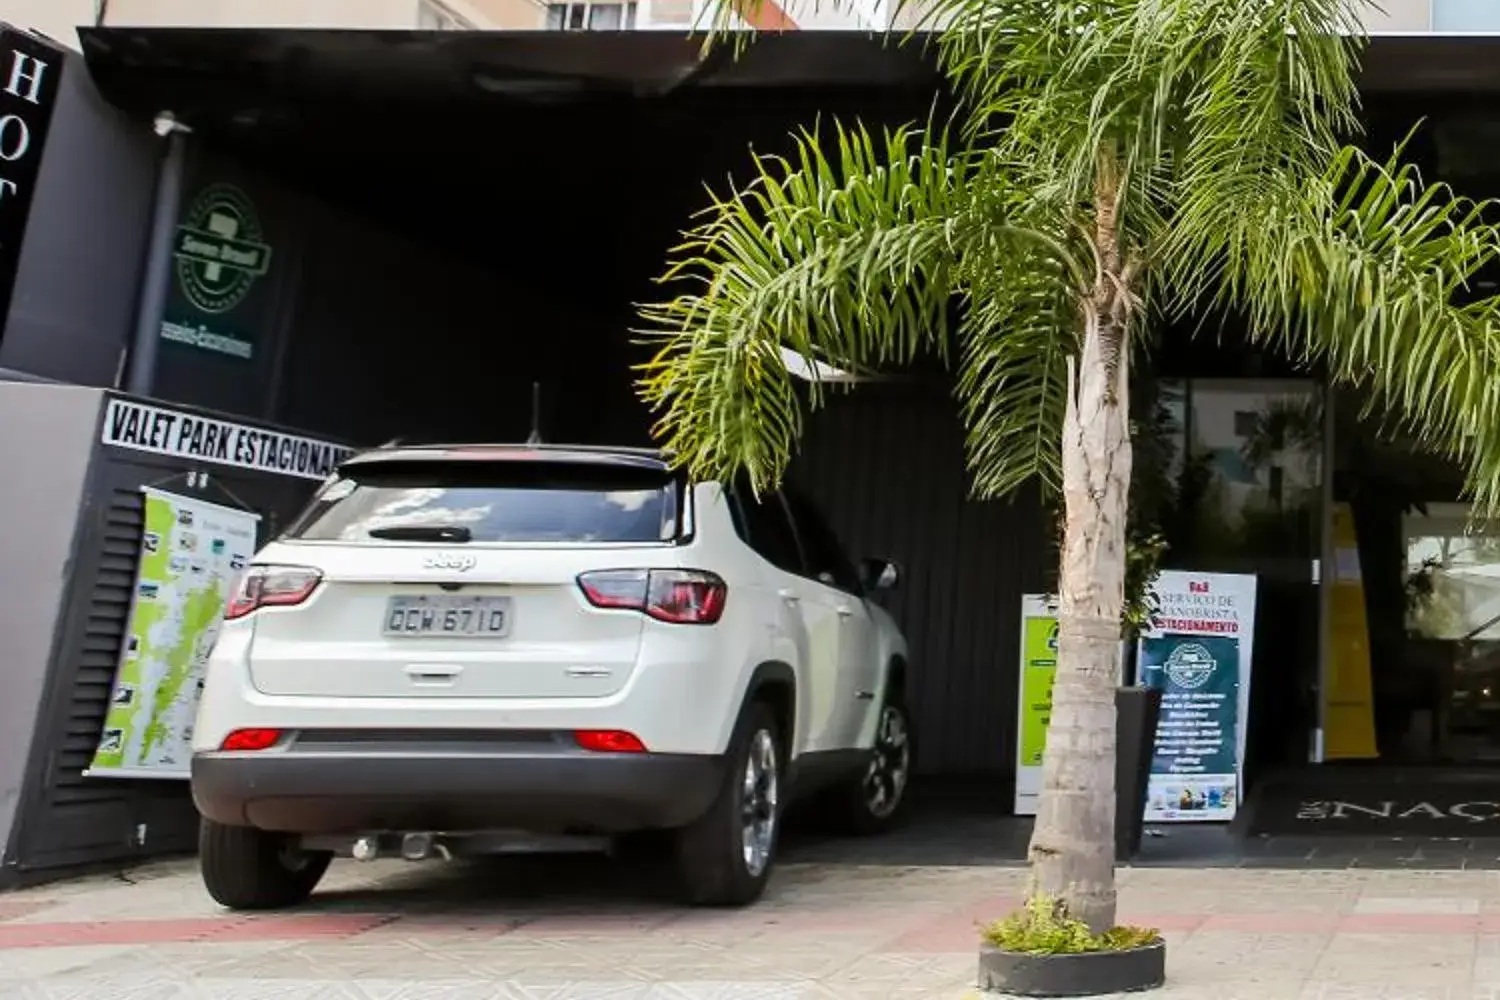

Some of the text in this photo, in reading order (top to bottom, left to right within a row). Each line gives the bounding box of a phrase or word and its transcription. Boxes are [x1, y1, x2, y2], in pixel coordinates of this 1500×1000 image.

[110, 403, 350, 475] VALET PARK ESTACIONAM
[423, 551, 478, 573] Jeep
[1218, 595, 1234, 607] DE
